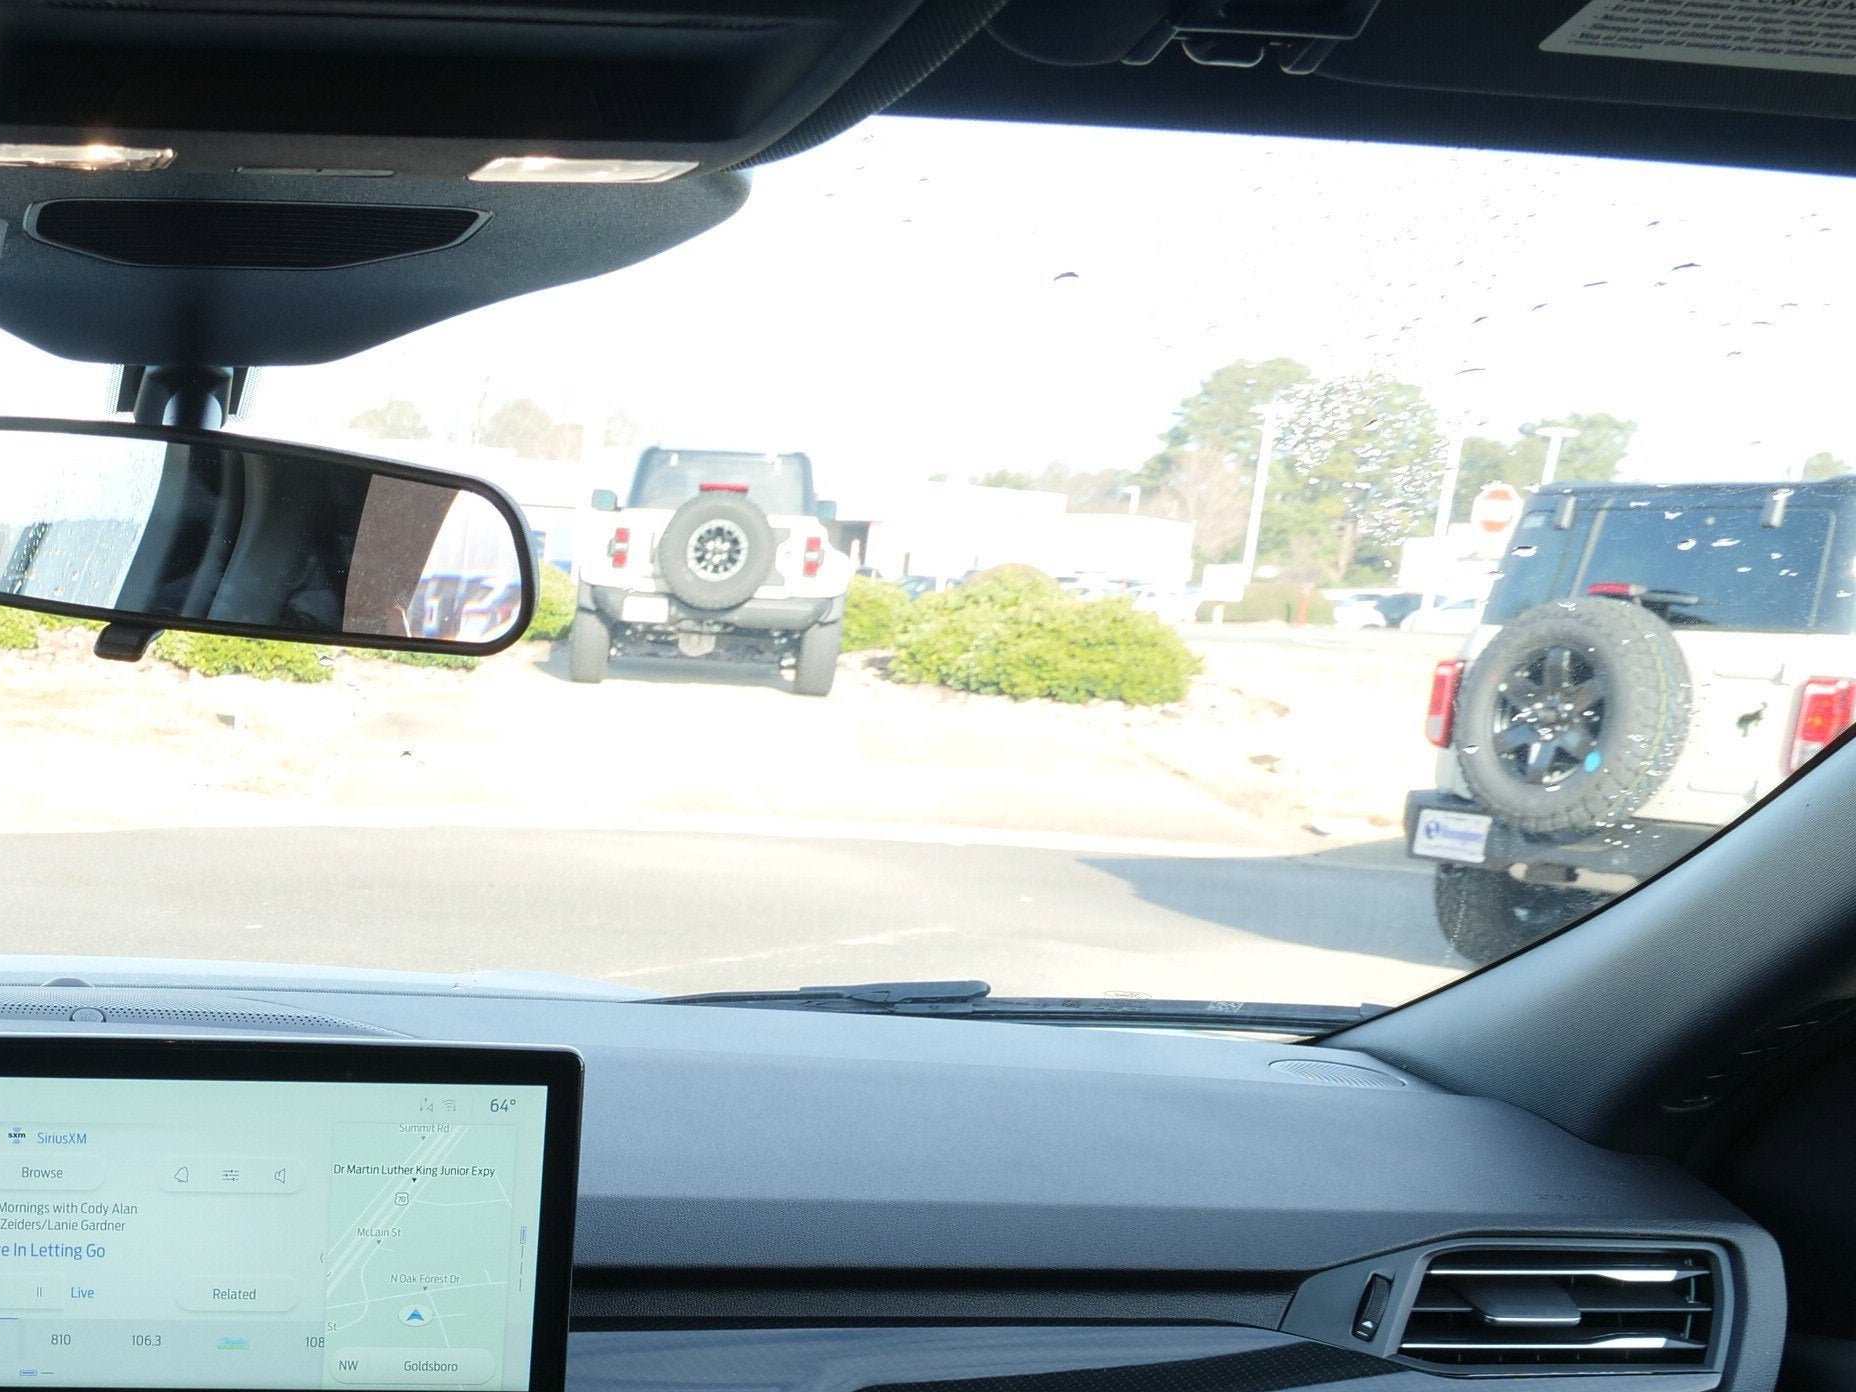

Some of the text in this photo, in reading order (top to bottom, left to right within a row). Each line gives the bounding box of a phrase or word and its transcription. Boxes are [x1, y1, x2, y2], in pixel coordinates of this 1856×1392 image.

[490, 1098, 517, 1113] 64°
[437, 1124, 450, 1133] Rd
[37, 1132, 87, 1146] SiriusXM
[21, 1166, 64, 1179] Browse
[334, 1164, 495, 1178] Dr Martin Luther King Junior Expy
[53, 1202, 78, 1215] with
[80, 1202, 109, 1218] Cody
[111, 1203, 138, 1216] Alan
[0, 1218, 79, 1232] Zeiders/Lanie
[81, 1219, 125, 1232] Gardner
[391, 1228, 401, 1237] St
[13, 1242, 27, 1258] In
[30, 1242, 82, 1260] Letting
[86, 1244, 106, 1259] Go
[390, 1274, 460, 1284] N Oak Forest Dr
[70, 1286, 95, 1300] Live
[213, 1288, 257, 1301] Related
[50, 1334, 72, 1346] 810
[131, 1335, 162, 1348] 106.3
[338, 1360, 359, 1371] NW
[403, 1359, 458, 1373] Goldsboro
